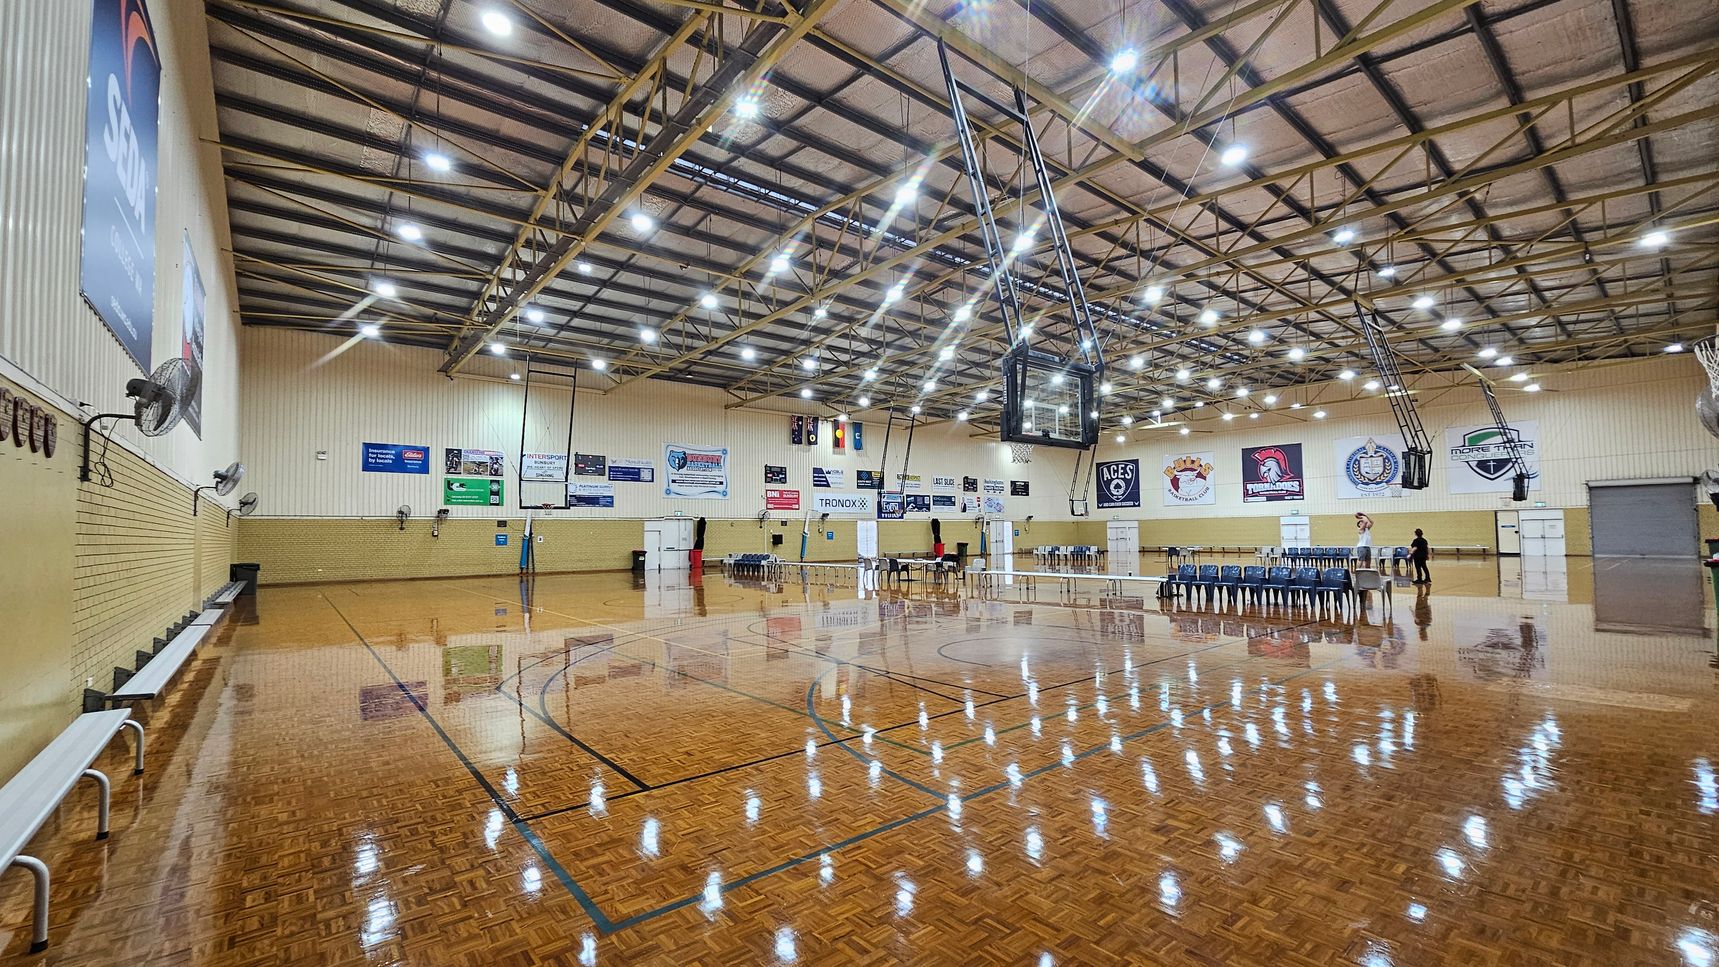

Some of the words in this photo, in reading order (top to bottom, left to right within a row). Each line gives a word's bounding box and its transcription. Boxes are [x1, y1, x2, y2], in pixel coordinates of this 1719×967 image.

[103, 73, 146, 234] SEDA
[1451, 447, 1490, 455] MORE
[1103, 464, 1133, 481] ACES
[1163, 456, 1214, 479] BULLS
[933, 477, 943, 485] LAST
[1246, 481, 1300, 494] TORNADOES
[1168, 488, 1198, 501] BASKETBALL
[1198, 486, 1211, 499] CLUB
[819, 498, 858, 508] TRONOX
